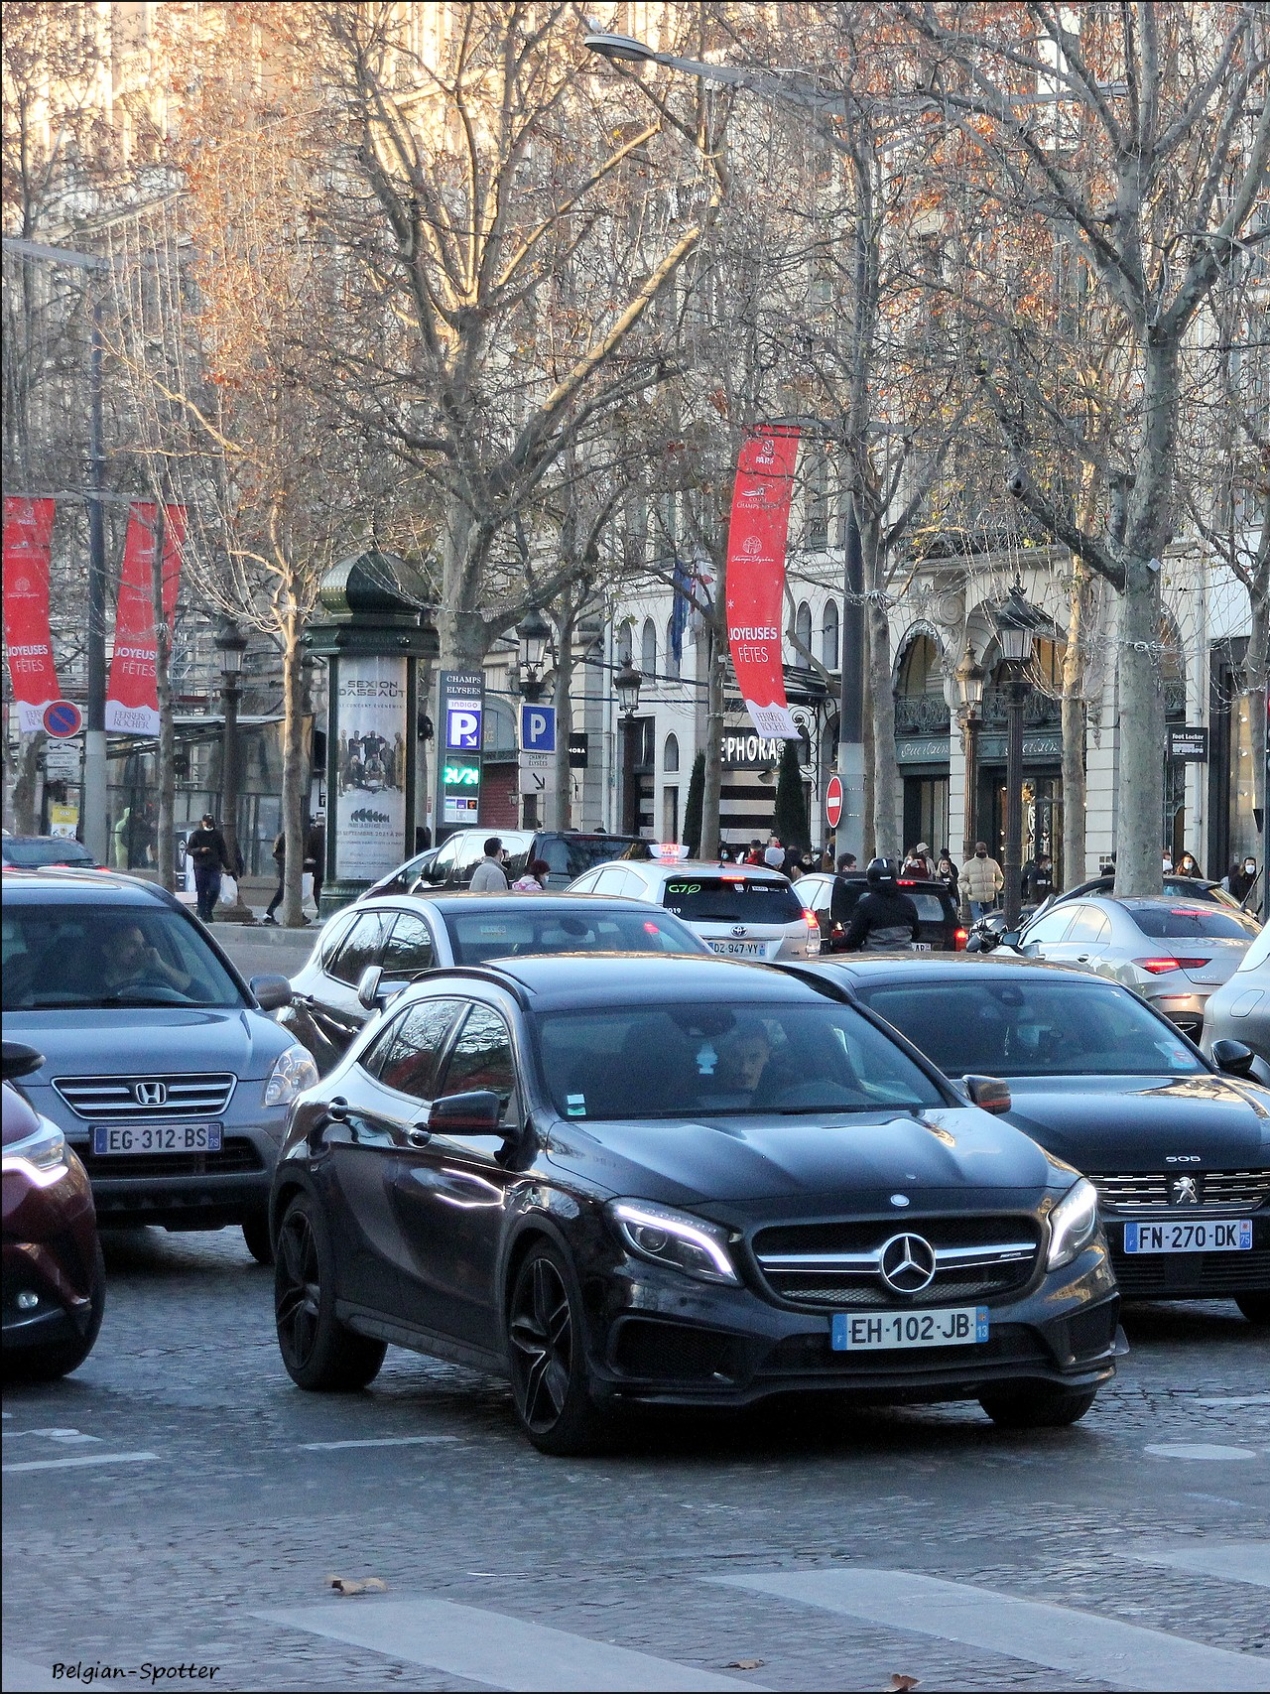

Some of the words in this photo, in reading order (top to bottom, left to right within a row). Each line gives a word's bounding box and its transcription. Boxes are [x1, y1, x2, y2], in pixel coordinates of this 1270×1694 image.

[729, 627, 778, 640] JOYEUSES
[6, 644, 48, 658] JOYEUSES
[115, 647, 157, 660] JOYEUS
[738, 644, 769, 663] FÊTES
[16, 658, 44, 672] FÊTES
[122, 661, 157, 677] FÊTES
[347, 680, 397, 689] SEXION
[446, 675, 482, 684] CHAMPS
[446, 686, 481, 695] ELYSEES
[114, 710, 152, 722] FERRERO
[114, 718, 149, 730] ROCHER
[450, 712, 477, 746] P
[530, 713, 547, 743] P
[444, 766, 479, 785] 24/24
[713, 942, 759, 955] DZ-947-VY
[110, 1128, 207, 1150] EG-312-BS
[1165, 1155, 1201, 1163] 508
[1139, 1224, 1237, 1249] FN-270-DK
[1240, 1233, 1250, 1246] 75
[851, 1313, 970, 1344] EH-102-JB
[976, 1325, 988, 1338] 13
